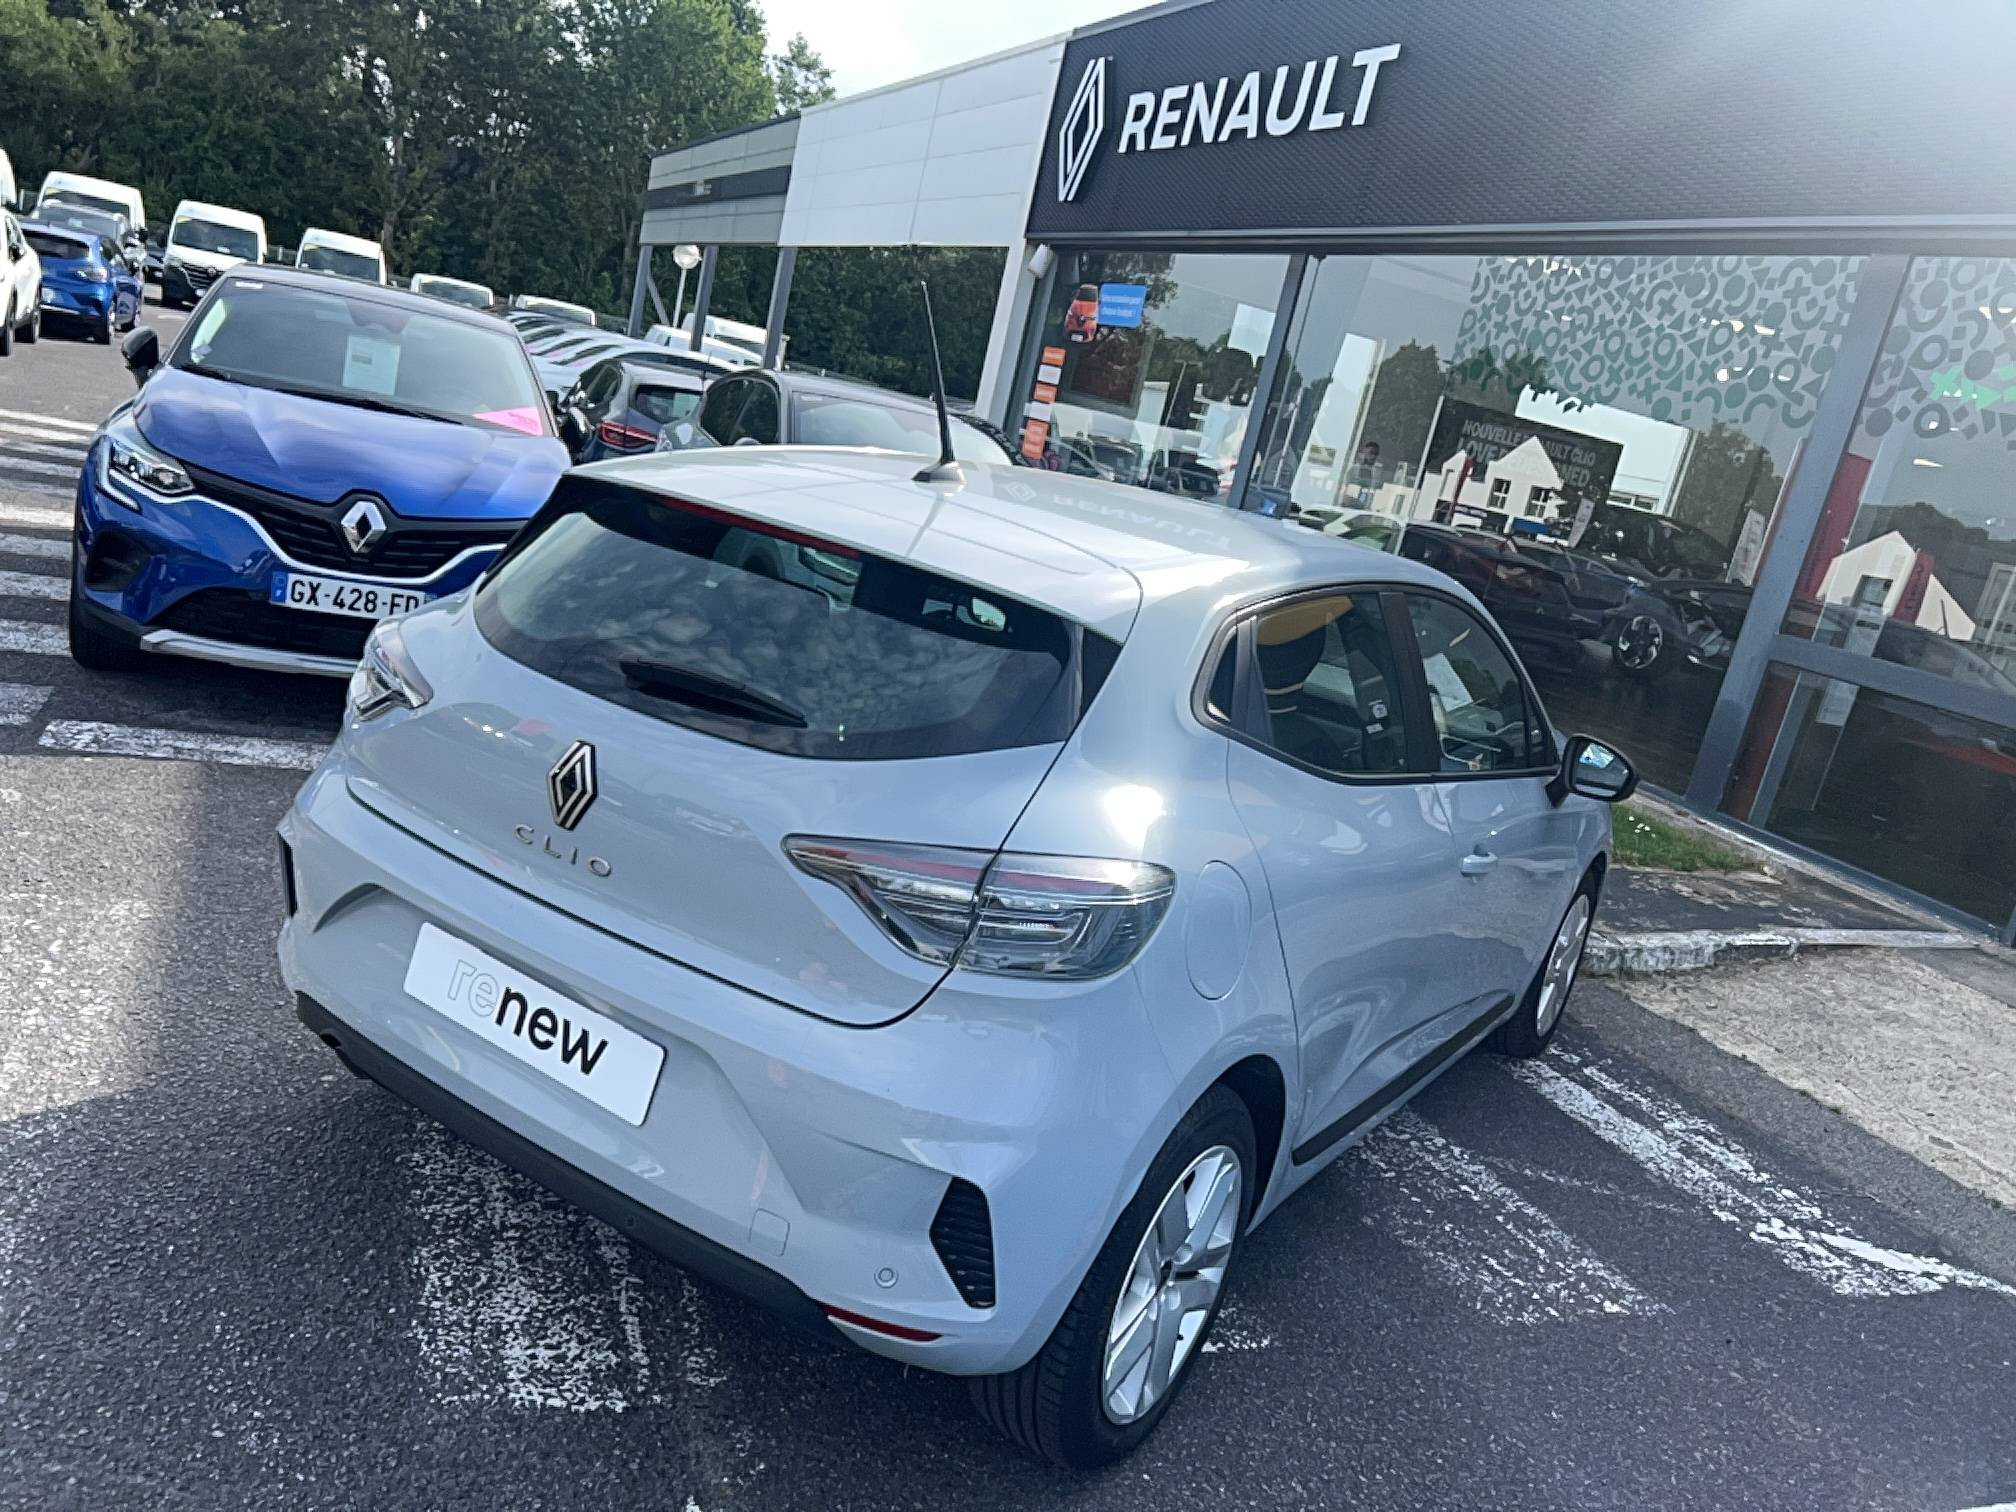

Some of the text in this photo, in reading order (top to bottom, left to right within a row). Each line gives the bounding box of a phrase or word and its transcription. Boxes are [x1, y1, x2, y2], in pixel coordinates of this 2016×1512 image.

[1117, 43, 1402, 154] RENAULT
[513, 823, 612, 877] CLIO
[448, 959, 609, 1076] renew
